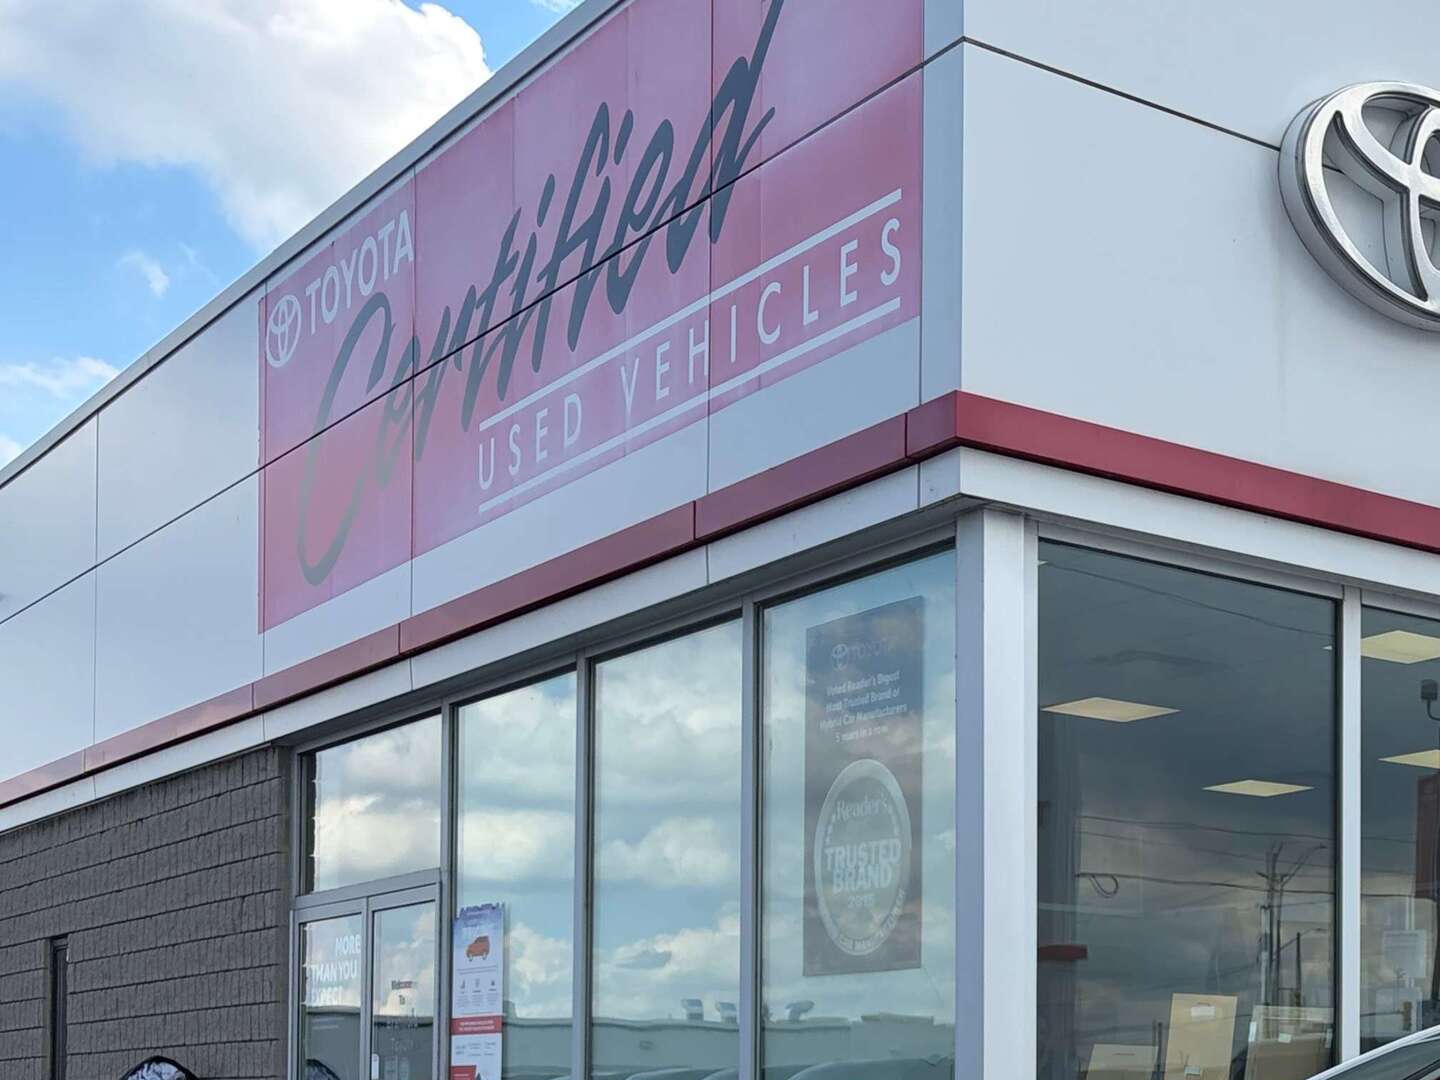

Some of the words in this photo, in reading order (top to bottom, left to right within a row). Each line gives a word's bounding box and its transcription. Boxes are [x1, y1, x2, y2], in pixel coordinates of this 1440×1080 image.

[305, 209, 413, 335] TOYOTA
[299, 0, 785, 585] Certified
[479, 392, 582, 490] USED
[621, 217, 901, 413] VEHICLES
[824, 838, 901, 871] TRUSTED
[832, 864, 892, 895] BRAND
[335, 933, 361, 957] MORE
[311, 961, 337, 983] THAN
[338, 959, 358, 980] YOU
